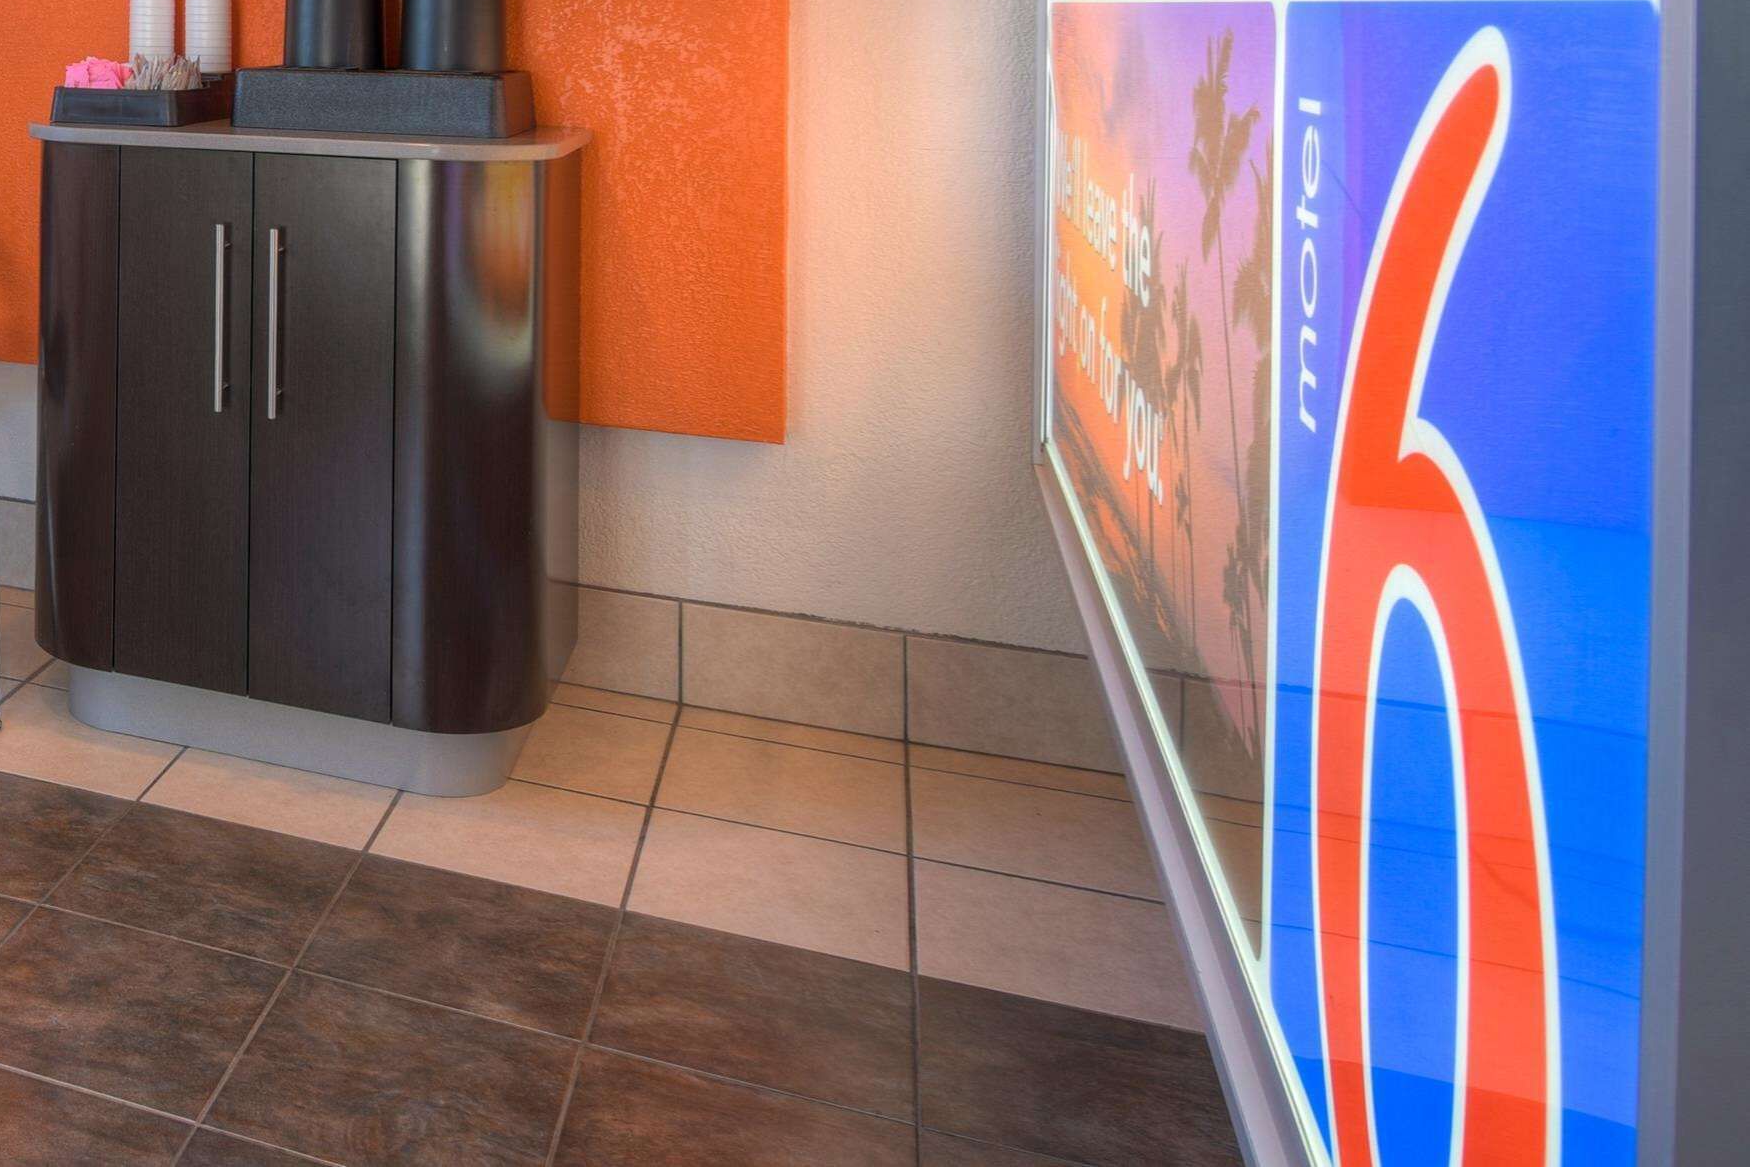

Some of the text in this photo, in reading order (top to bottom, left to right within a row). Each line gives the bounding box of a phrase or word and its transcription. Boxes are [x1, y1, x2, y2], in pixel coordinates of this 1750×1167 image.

[1121, 172, 1151, 308] the
[1296, 97, 1322, 433] motel
[1100, 295, 1123, 425] for
[1312, 25, 1563, 1167] 6
